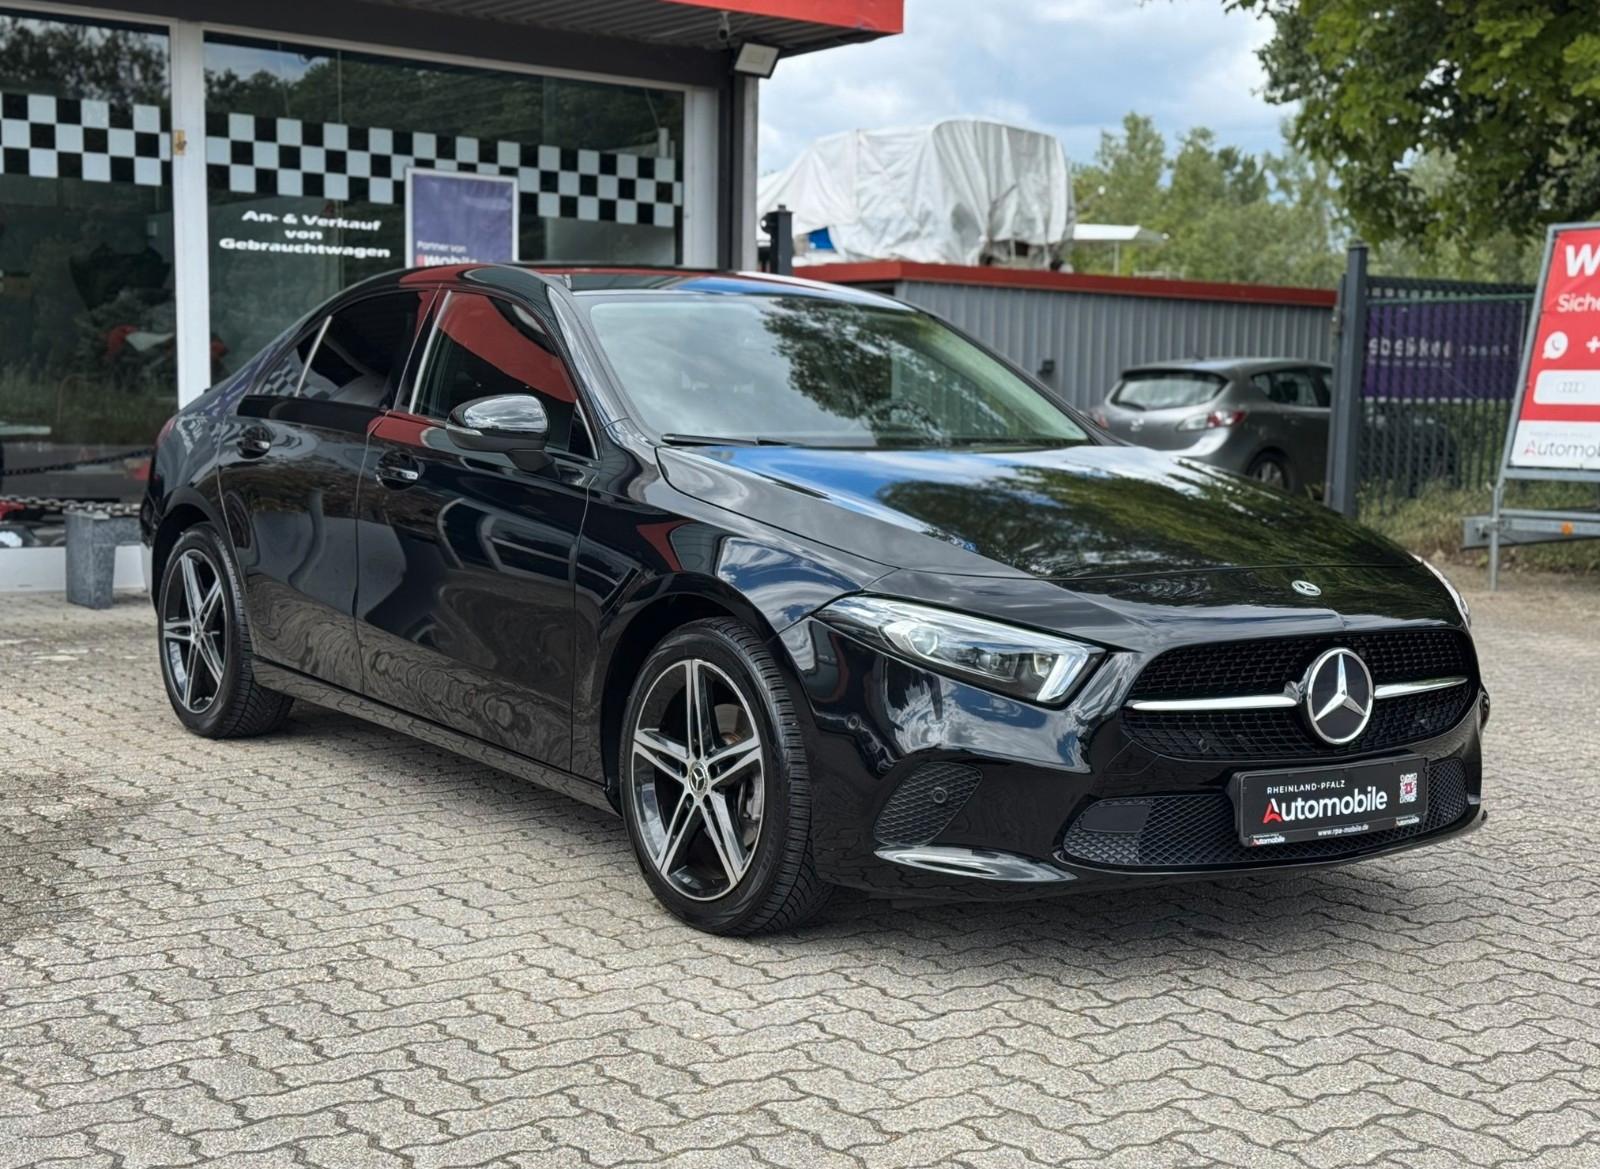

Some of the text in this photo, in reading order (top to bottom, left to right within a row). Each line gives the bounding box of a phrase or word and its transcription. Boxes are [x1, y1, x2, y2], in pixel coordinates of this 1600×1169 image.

[241, 210, 382, 231] An- & Verkauf
[284, 229, 323, 240] von
[219, 238, 391, 259] Gebrauchtwagen
[1266, 780, 1346, 795] RHEINLAND-PFALZ
[1262, 786, 1388, 824] Automobile
